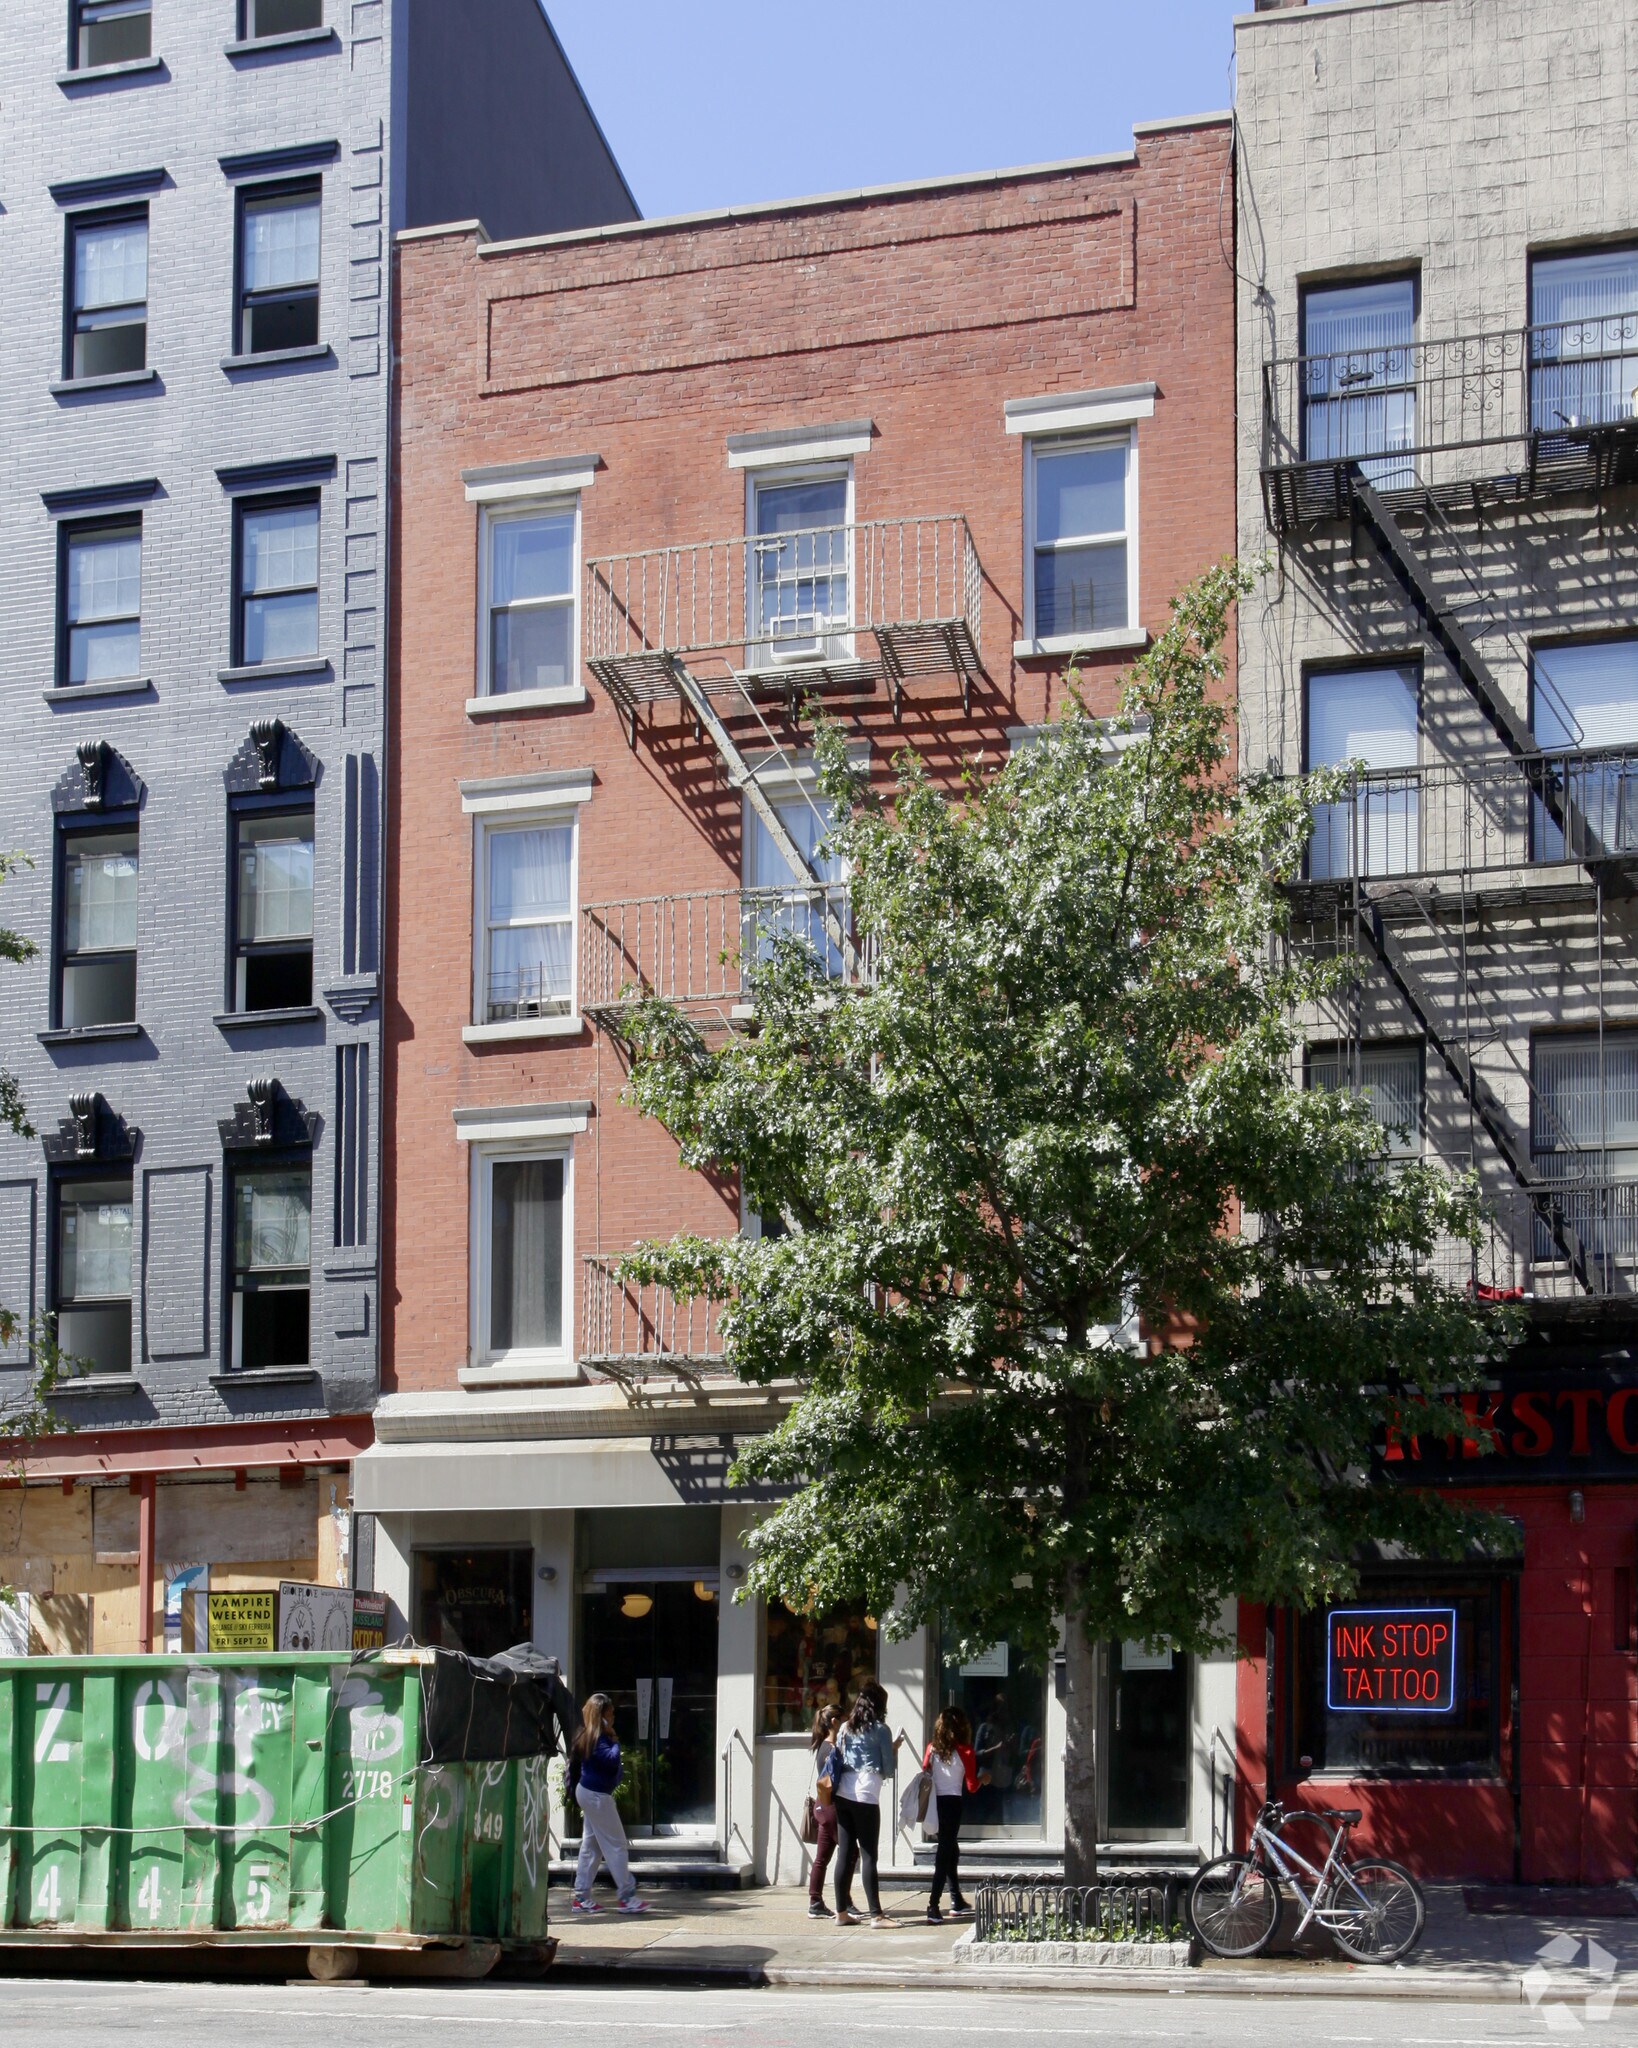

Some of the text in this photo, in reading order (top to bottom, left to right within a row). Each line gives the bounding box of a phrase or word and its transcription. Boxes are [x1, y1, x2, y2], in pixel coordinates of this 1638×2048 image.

[211, 1597, 271, 1608] VAMPIRE
[211, 1610, 271, 1620] WEEKEND
[233, 1637, 253, 1645] SEPT
[257, 1637, 268, 1645] 20
[1336, 1624, 1448, 1658] INK STOP
[1342, 1667, 1440, 1701] TATTOO
[342, 1770, 392, 1799] 2778
